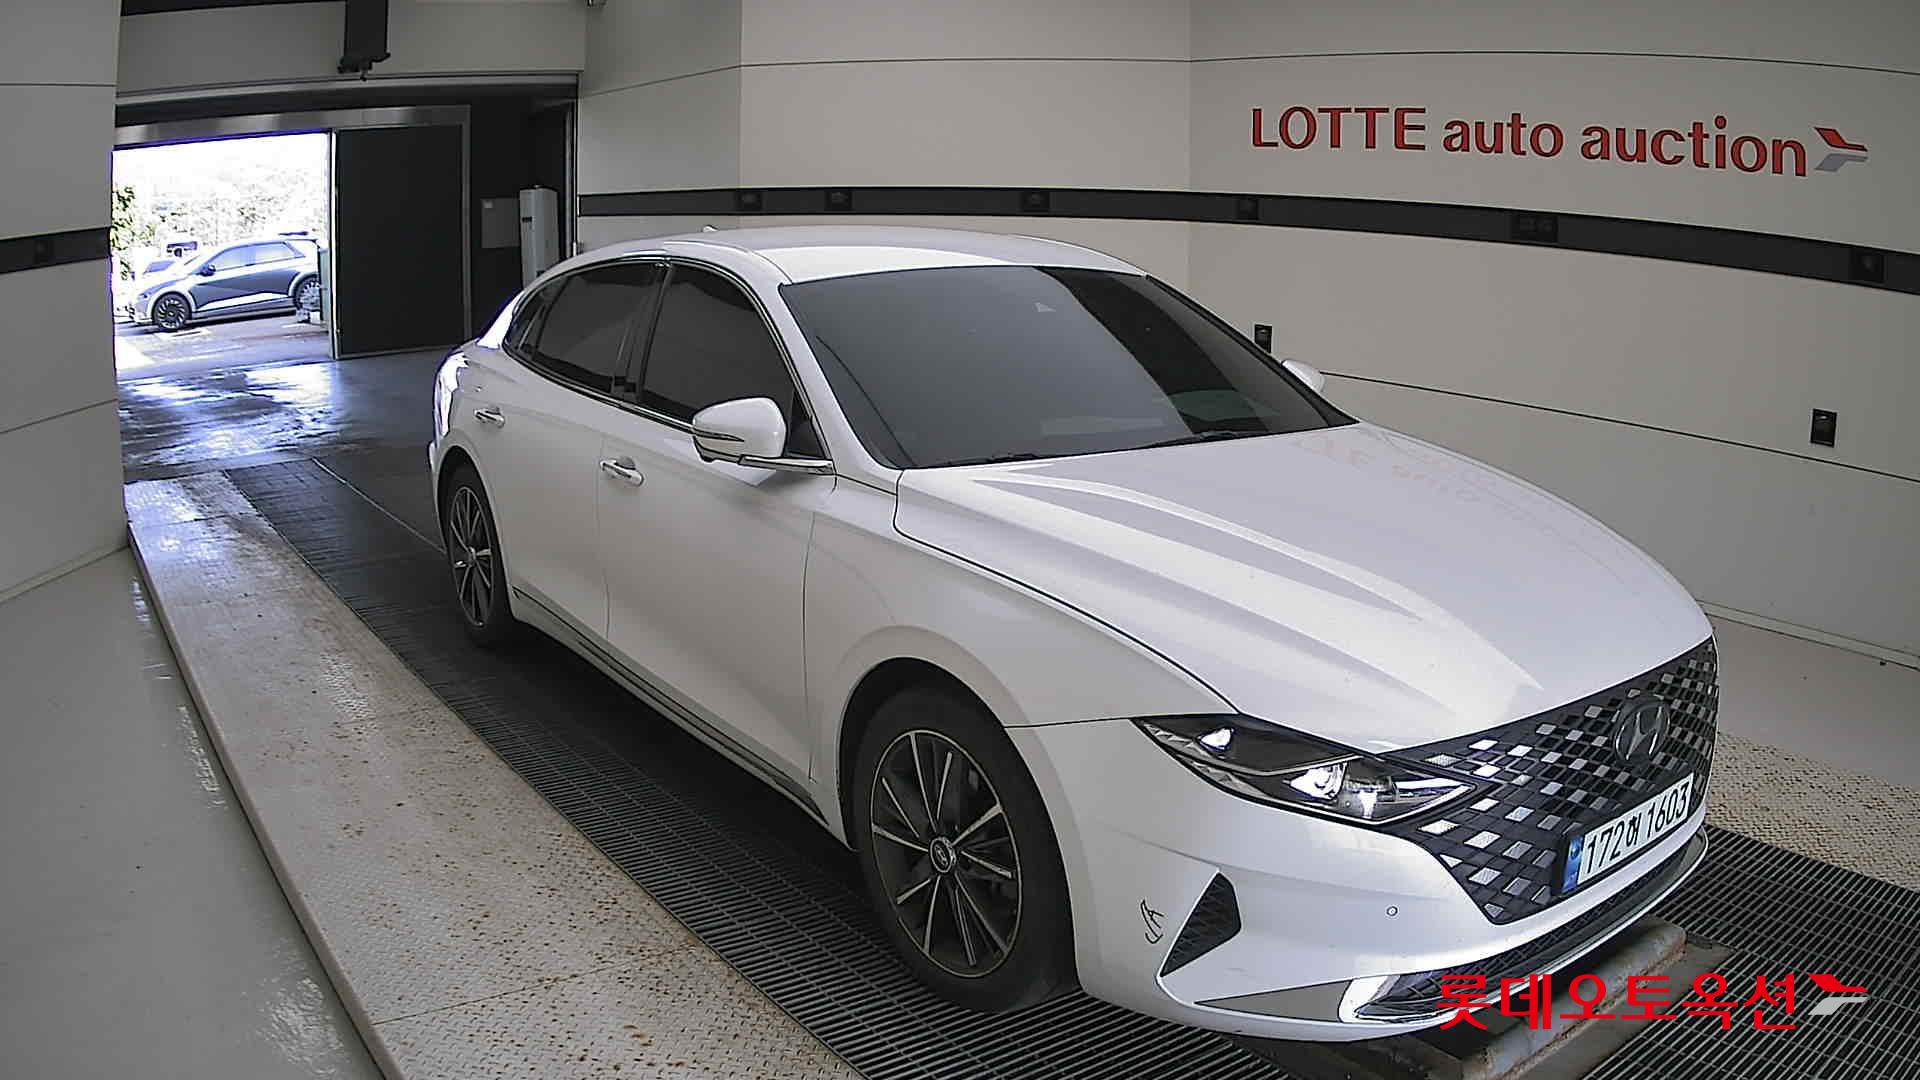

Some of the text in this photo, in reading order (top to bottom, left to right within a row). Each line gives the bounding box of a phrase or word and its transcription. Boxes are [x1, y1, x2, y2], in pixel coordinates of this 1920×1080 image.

[1252, 106, 1808, 178] LOTTE auto auction
[1586, 781, 1690, 874] 172허 1603
